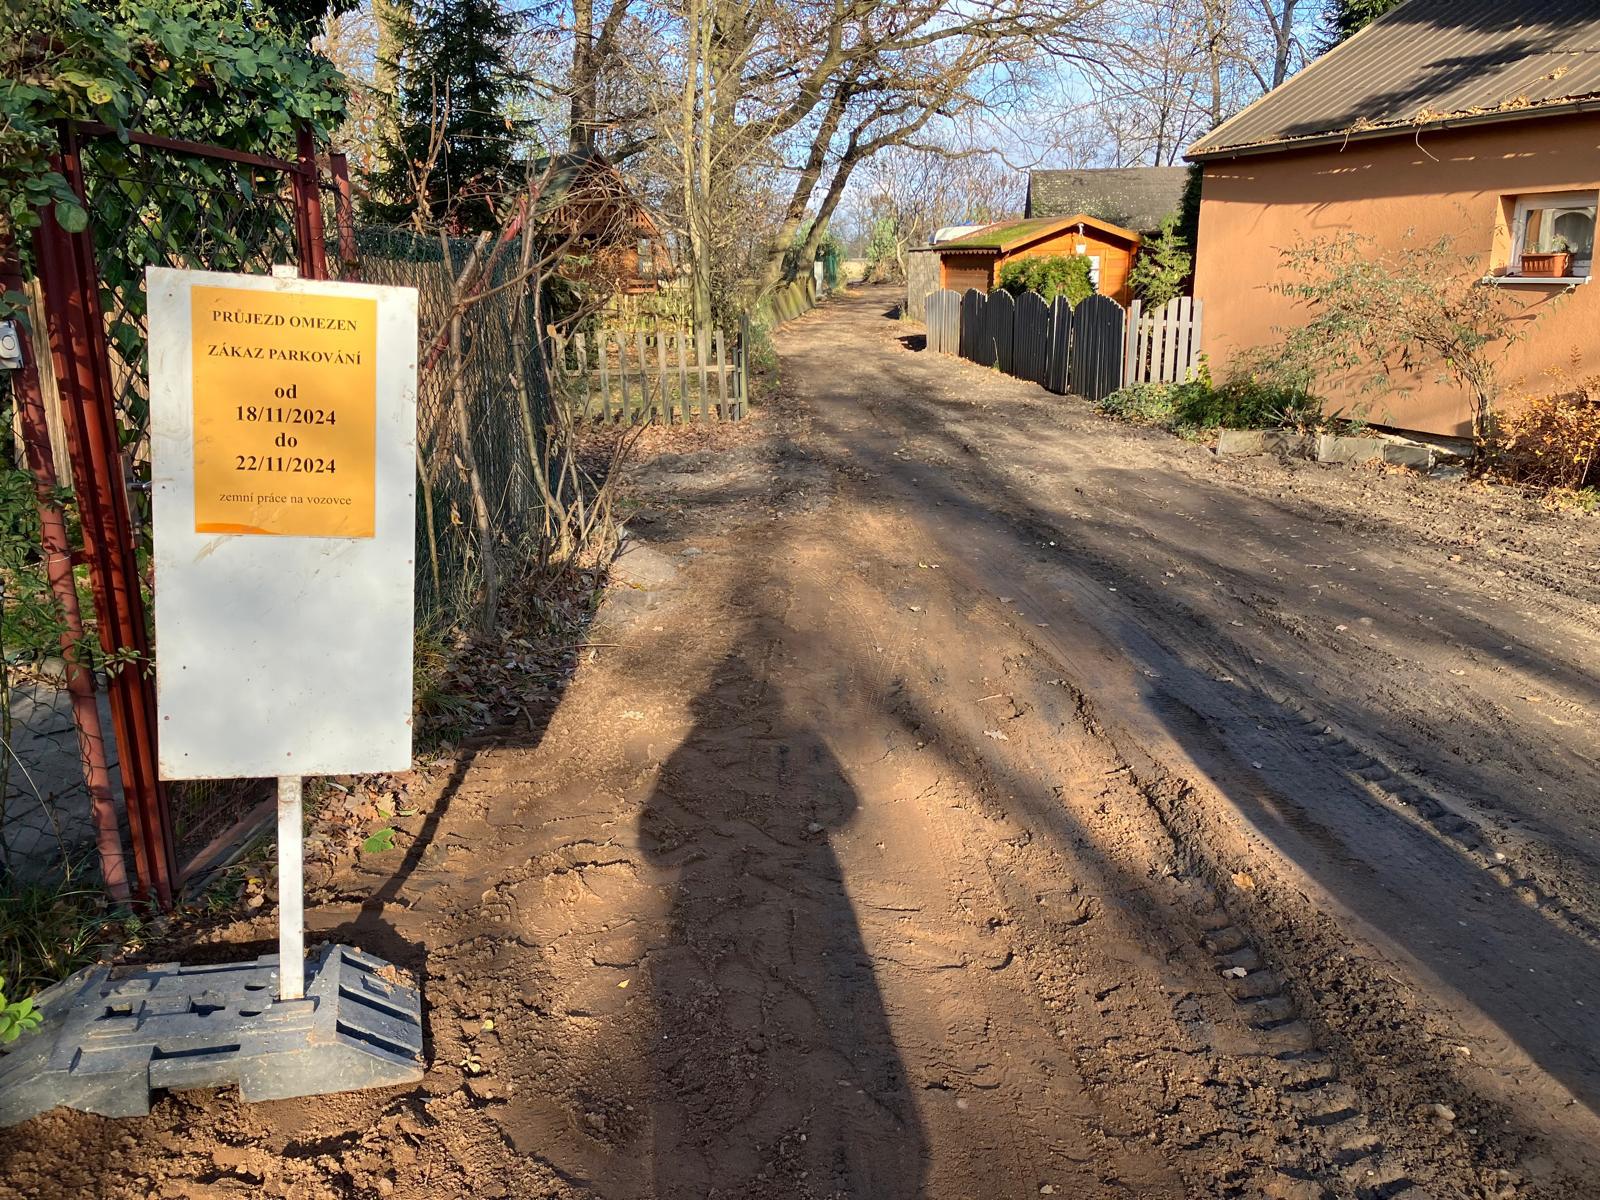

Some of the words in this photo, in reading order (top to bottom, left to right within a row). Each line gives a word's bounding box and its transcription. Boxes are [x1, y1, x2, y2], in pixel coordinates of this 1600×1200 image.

[212, 308, 285, 327] PRŮJEZD
[289, 316, 357, 331] OMEZEN
[207, 342, 265, 360] ZÁKAZ
[269, 349, 362, 365] PARKOVÁNÍ
[274, 384, 297, 399] od
[235, 405, 336, 425] 18/11/2024
[274, 432, 298, 448] do
[235, 455, 336, 474] 22/11/2024
[219, 492, 254, 503] zemní
[257, 492, 287, 505] práce
[290, 496, 303, 504] na
[307, 496, 352, 505] vozovce
